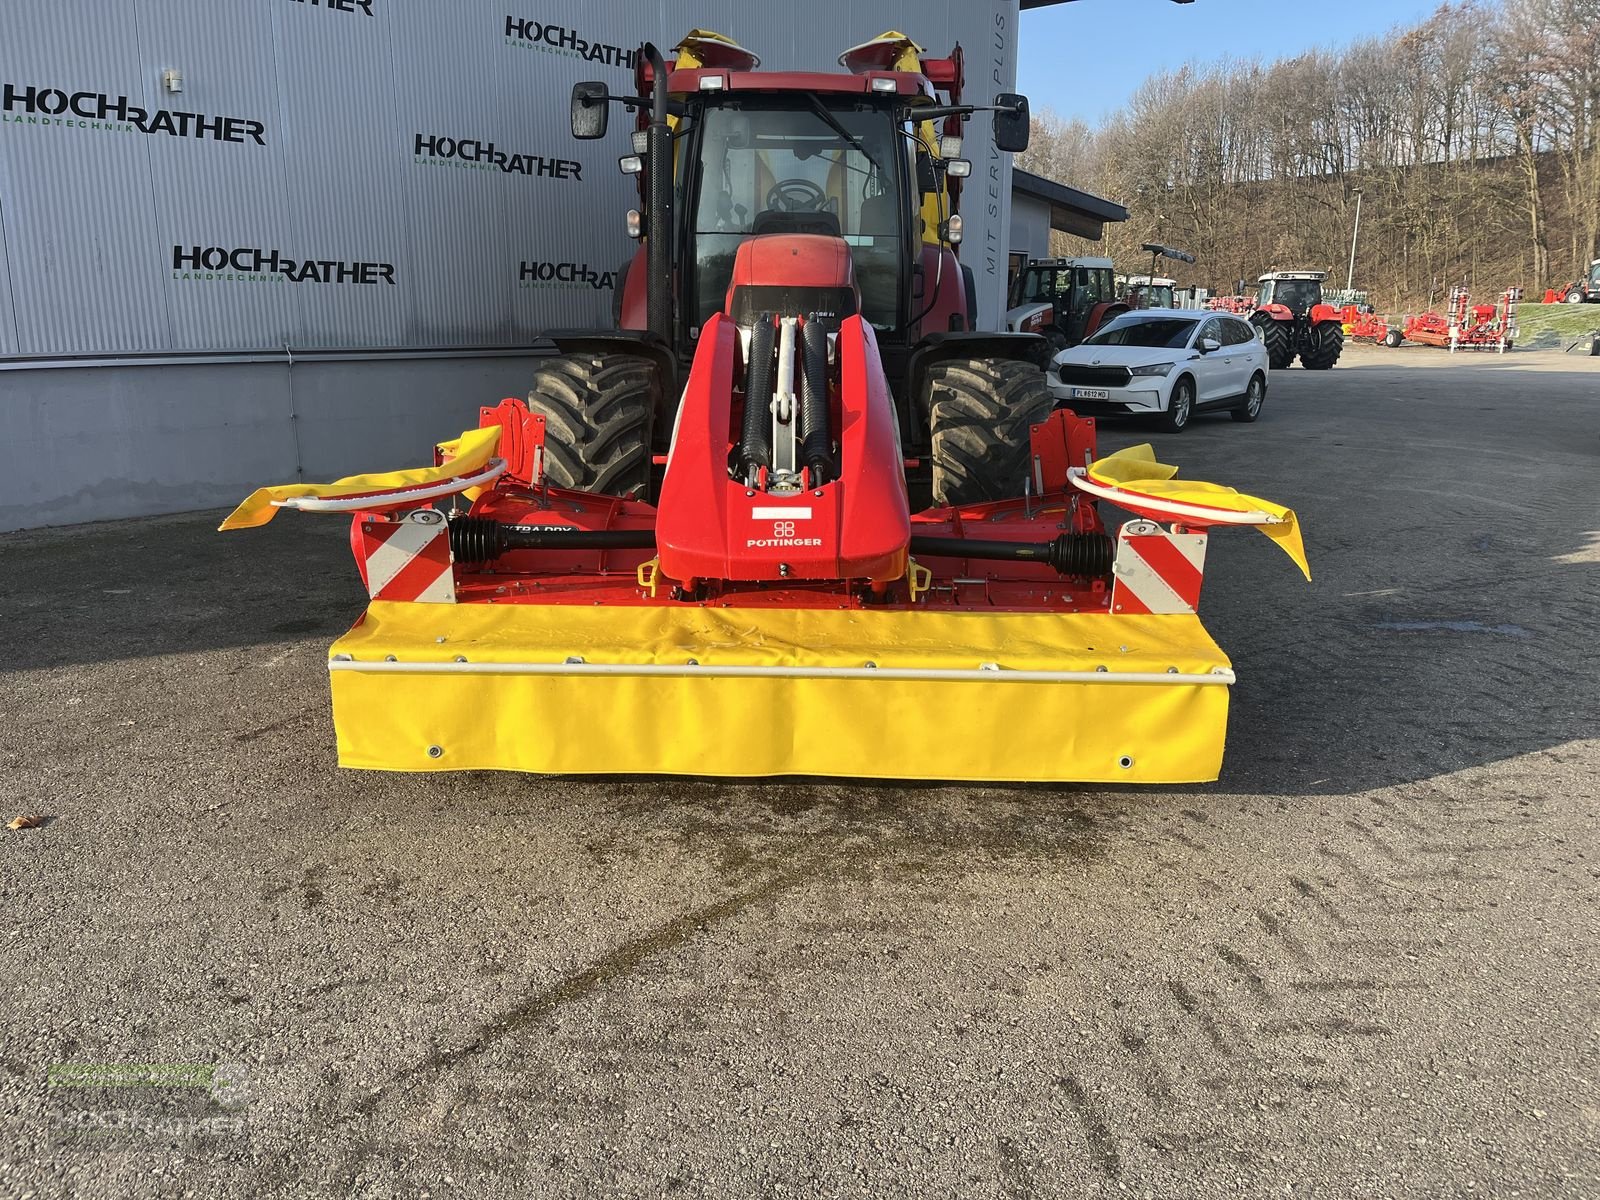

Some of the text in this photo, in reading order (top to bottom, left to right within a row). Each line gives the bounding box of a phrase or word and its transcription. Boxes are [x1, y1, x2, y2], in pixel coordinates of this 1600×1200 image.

[504, 38, 580, 60] LANDTECHNIK
[505, 15, 637, 70] HOCHRATH
[2, 83, 266, 146] HOCHRATHER
[2, 113, 134, 133] LANDTECHNIK
[414, 133, 582, 181] HOCHRATHER
[985, 12, 1005, 275] MIT SERV PLUS
[414, 157, 498, 172] LANDTECHNIK
[172, 244, 396, 285] HOCHRATHER
[172, 272, 285, 283] LANDTECHNIK
[519, 261, 619, 290] HOCHRA
